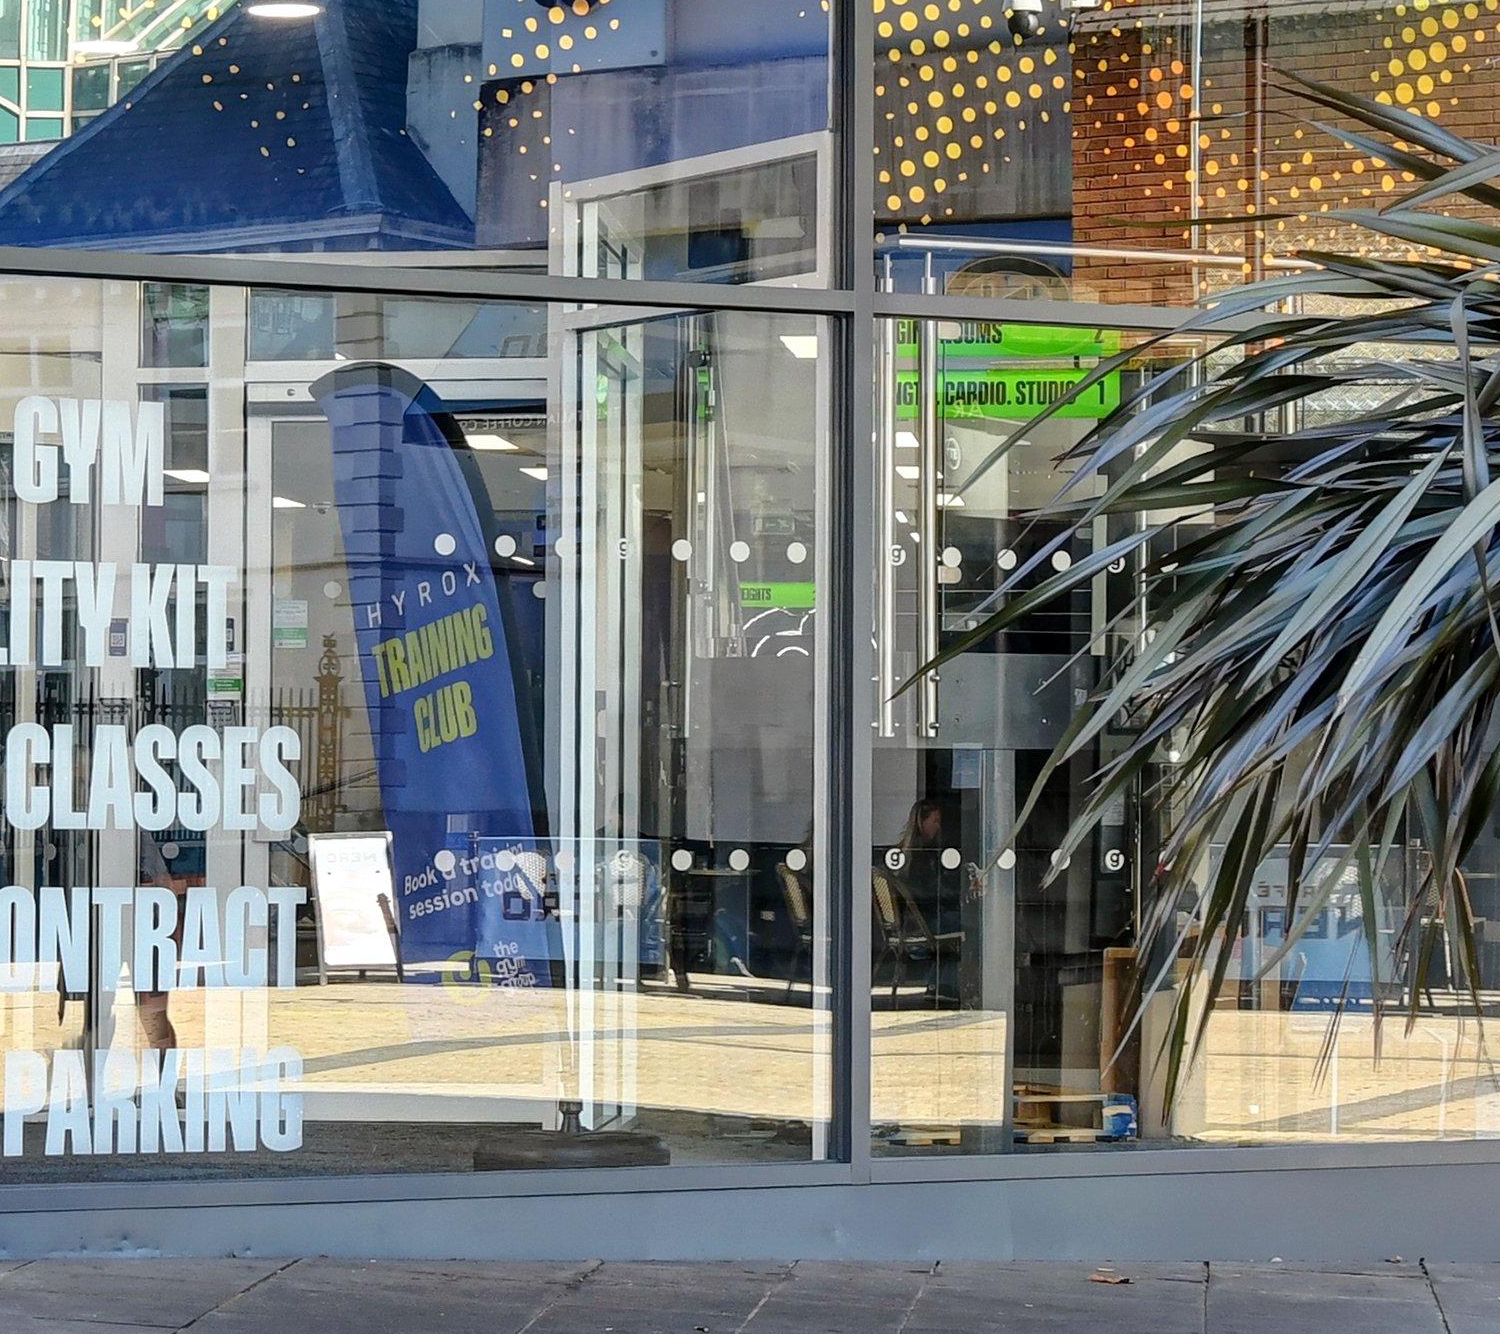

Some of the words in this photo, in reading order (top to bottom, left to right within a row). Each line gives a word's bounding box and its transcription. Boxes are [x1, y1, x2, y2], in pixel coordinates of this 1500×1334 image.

[12, 396, 165, 507] GYM
[123, 561, 237, 669] KIT
[366, 561, 480, 628] HYROX
[372, 603, 494, 699] TRAINING
[414, 681, 477, 753] CLUB
[5, 723, 301, 832] CLASSES
[404, 865, 438, 896] Book
[408, 887, 479, 919] session
[481, 872, 523, 898] toda
[3, 1048, 303, 1159] PARKING
